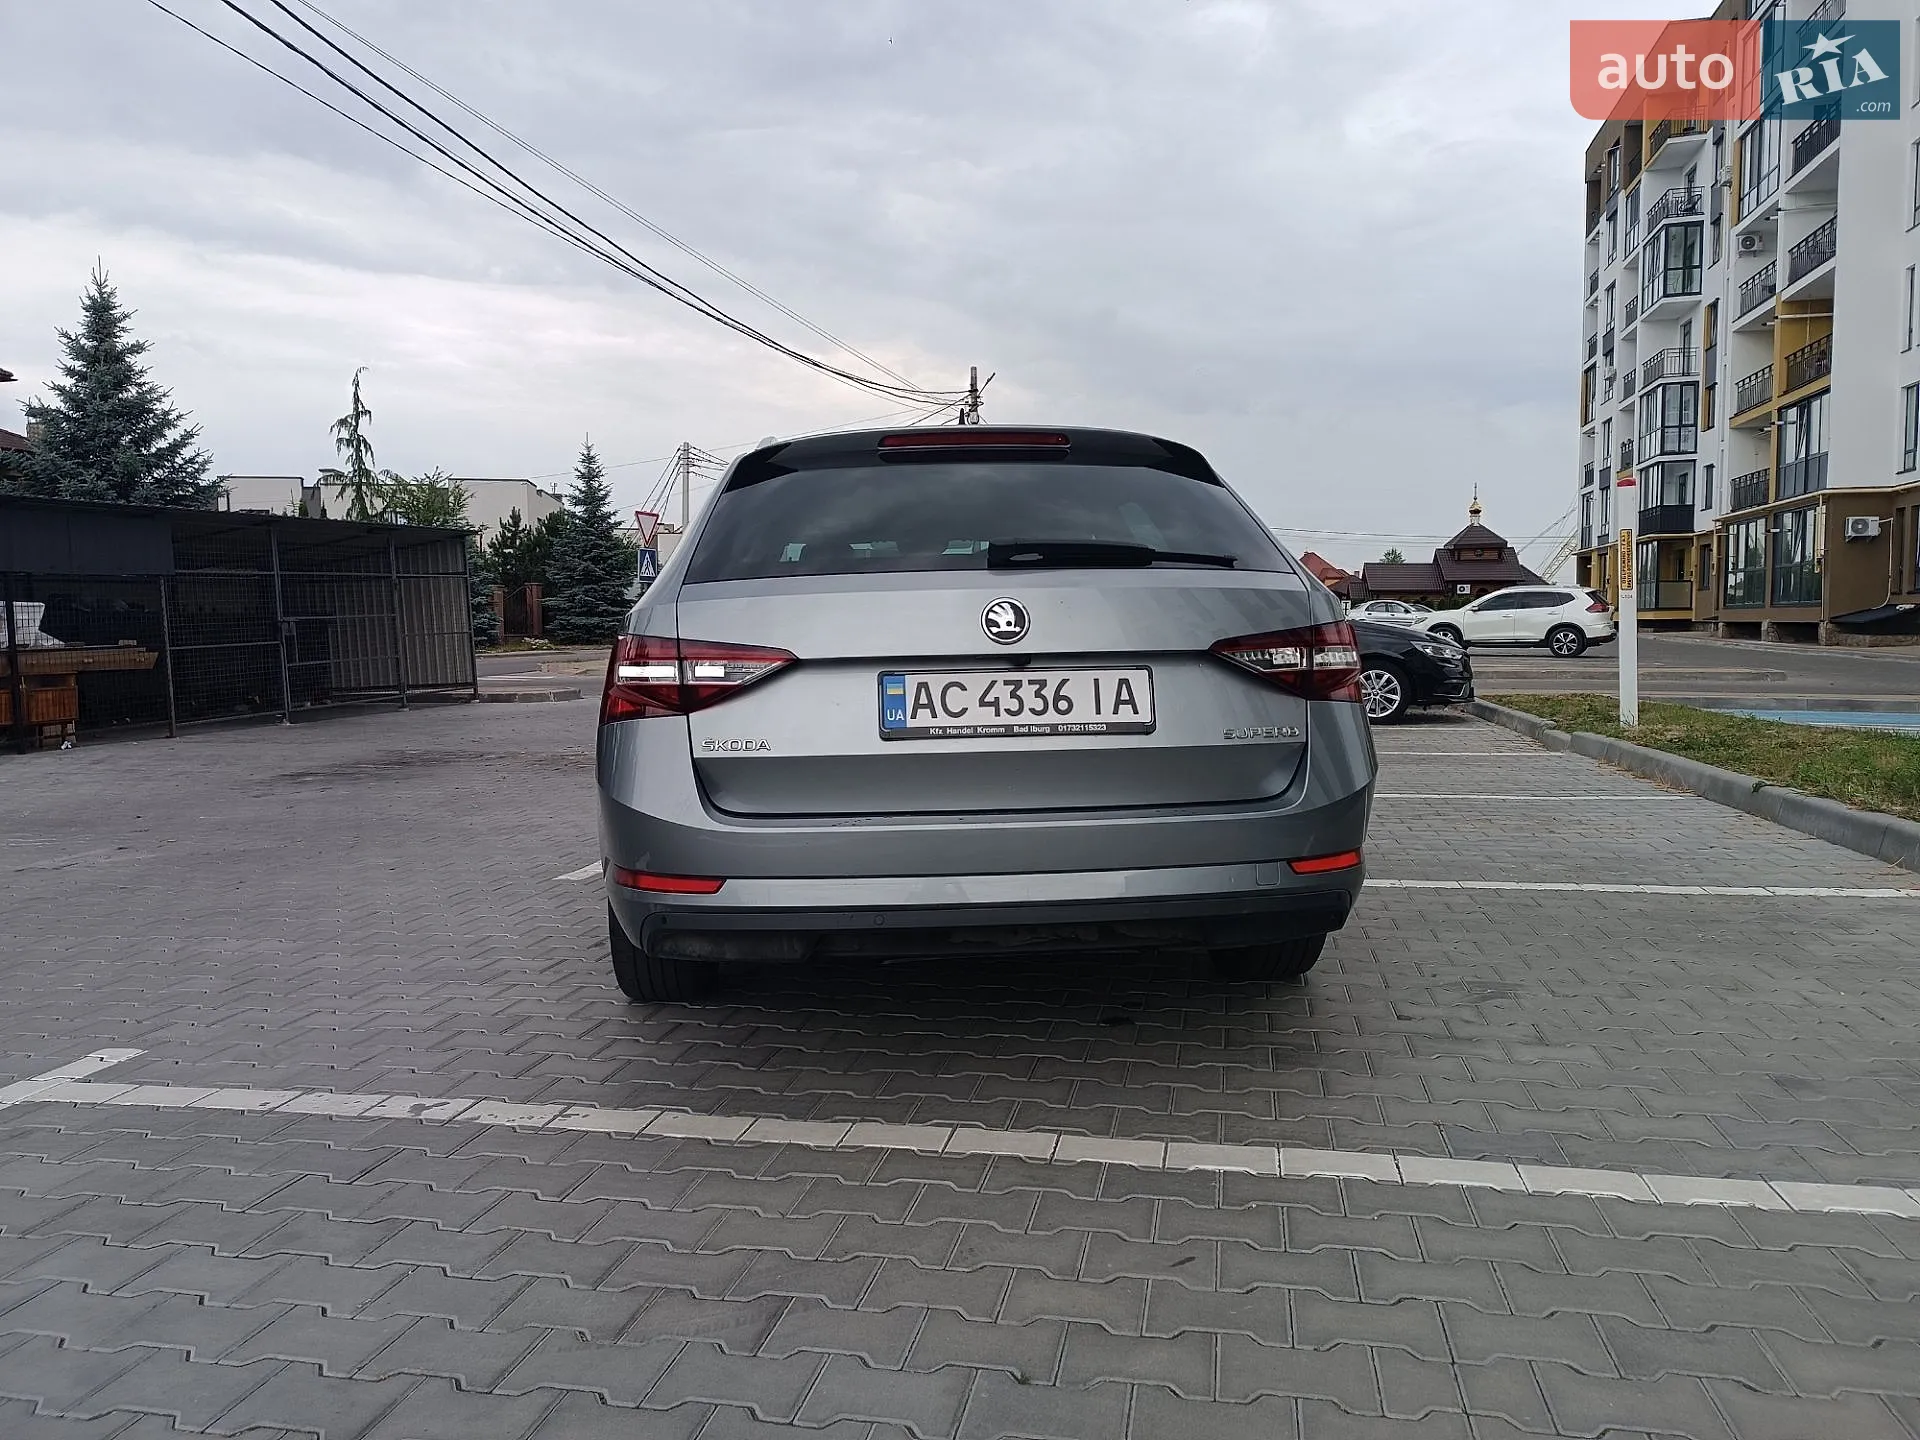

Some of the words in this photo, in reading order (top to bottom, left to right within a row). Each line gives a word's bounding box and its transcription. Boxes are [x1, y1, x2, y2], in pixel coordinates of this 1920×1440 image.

[910, 681, 968, 719] AC
[978, 678, 1073, 717] 4336
[1094, 677, 1139, 715] IA
[887, 710, 904, 721] UA
[946, 725, 974, 735] Handel
[977, 726, 1005, 735] Kromm
[1013, 725, 1028, 734] Bad
[1030, 725, 1050, 736] Iburg
[1223, 727, 1299, 739] SUPERB
[701, 737, 771, 752] ŠKODA
